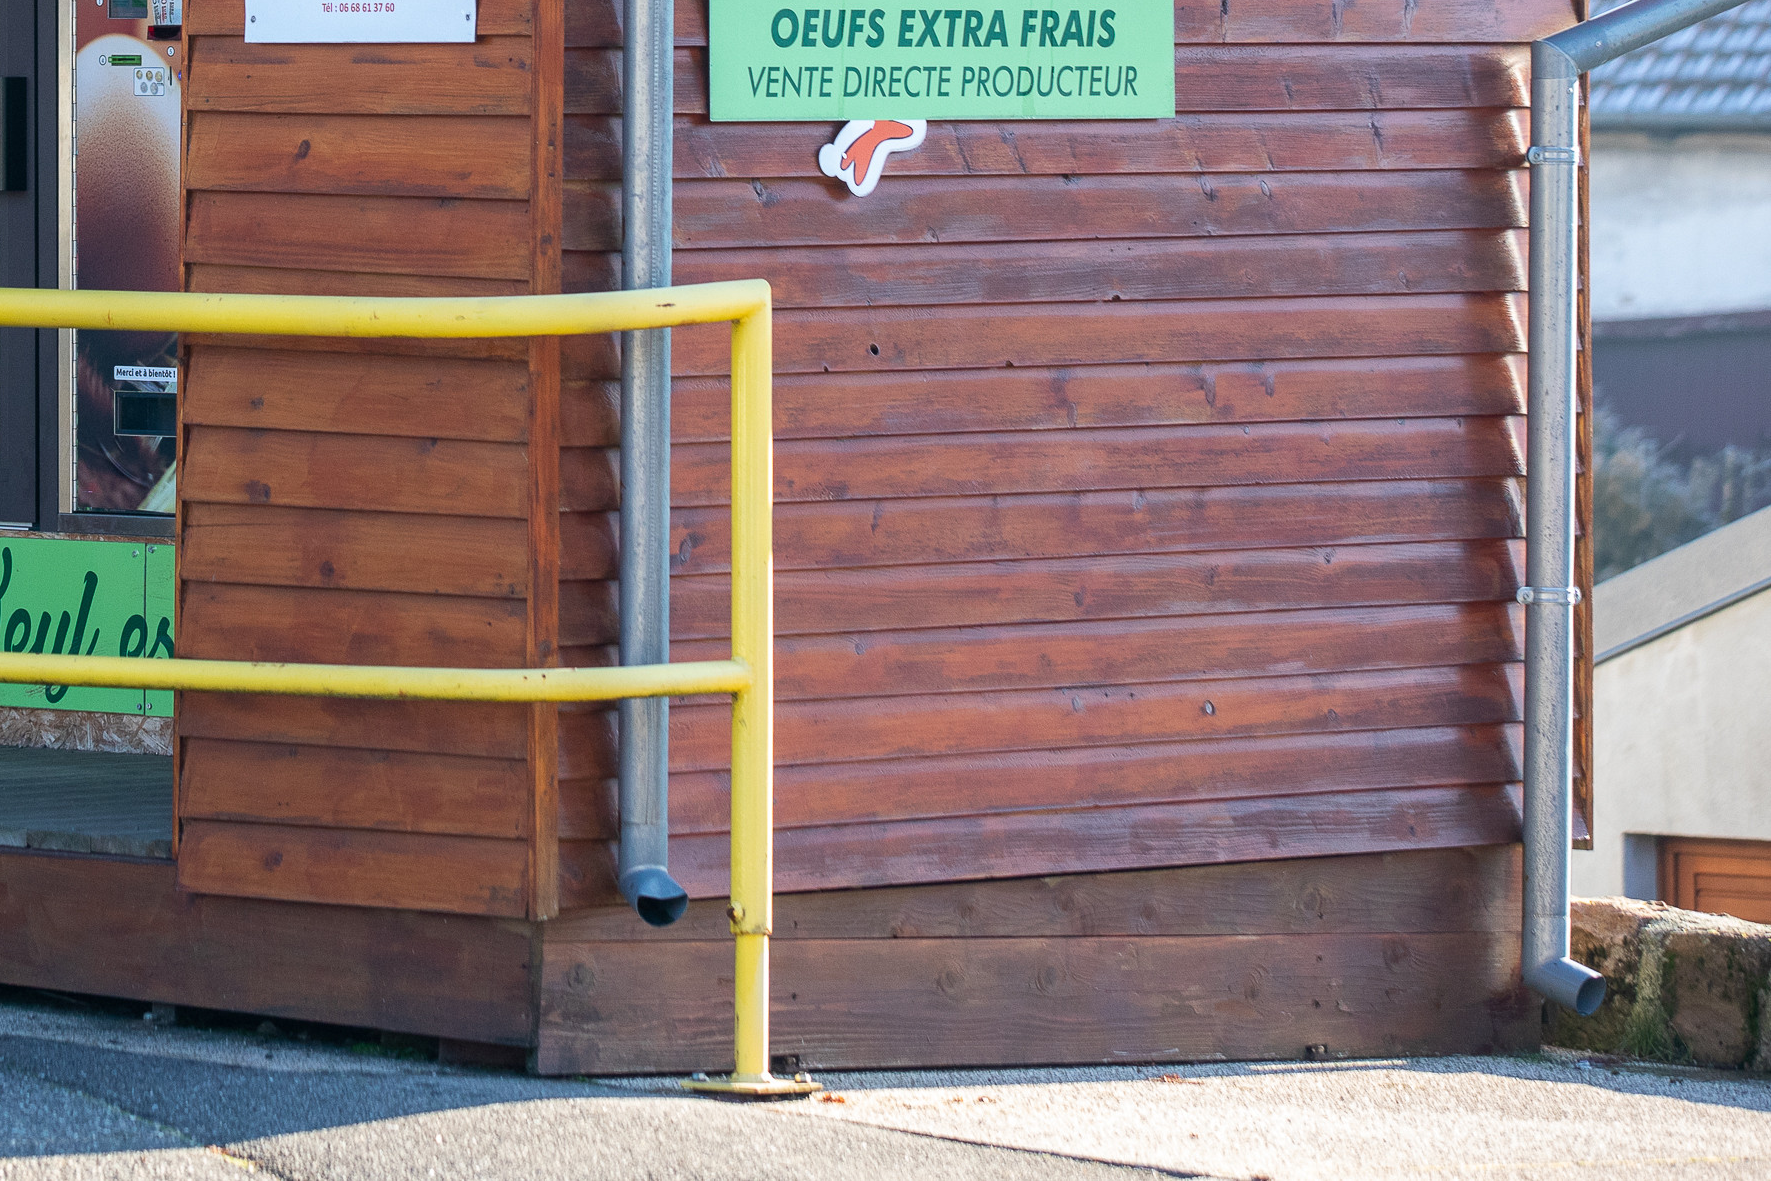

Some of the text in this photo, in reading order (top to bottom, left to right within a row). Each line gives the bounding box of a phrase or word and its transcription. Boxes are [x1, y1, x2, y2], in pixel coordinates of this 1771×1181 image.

[322, 2, 395, 12] Tél 06 68 61 37 60
[771, 8, 1116, 48] OEUFS EXTRA FRAIS
[747, 66, 1138, 97] VENTE DIRECTE PRODUCTEUR
[116, 368, 134, 377] Merci
[135, 369, 142, 377] et
[143, 369, 147, 377] à
[149, 369, 172, 378] bientôt
